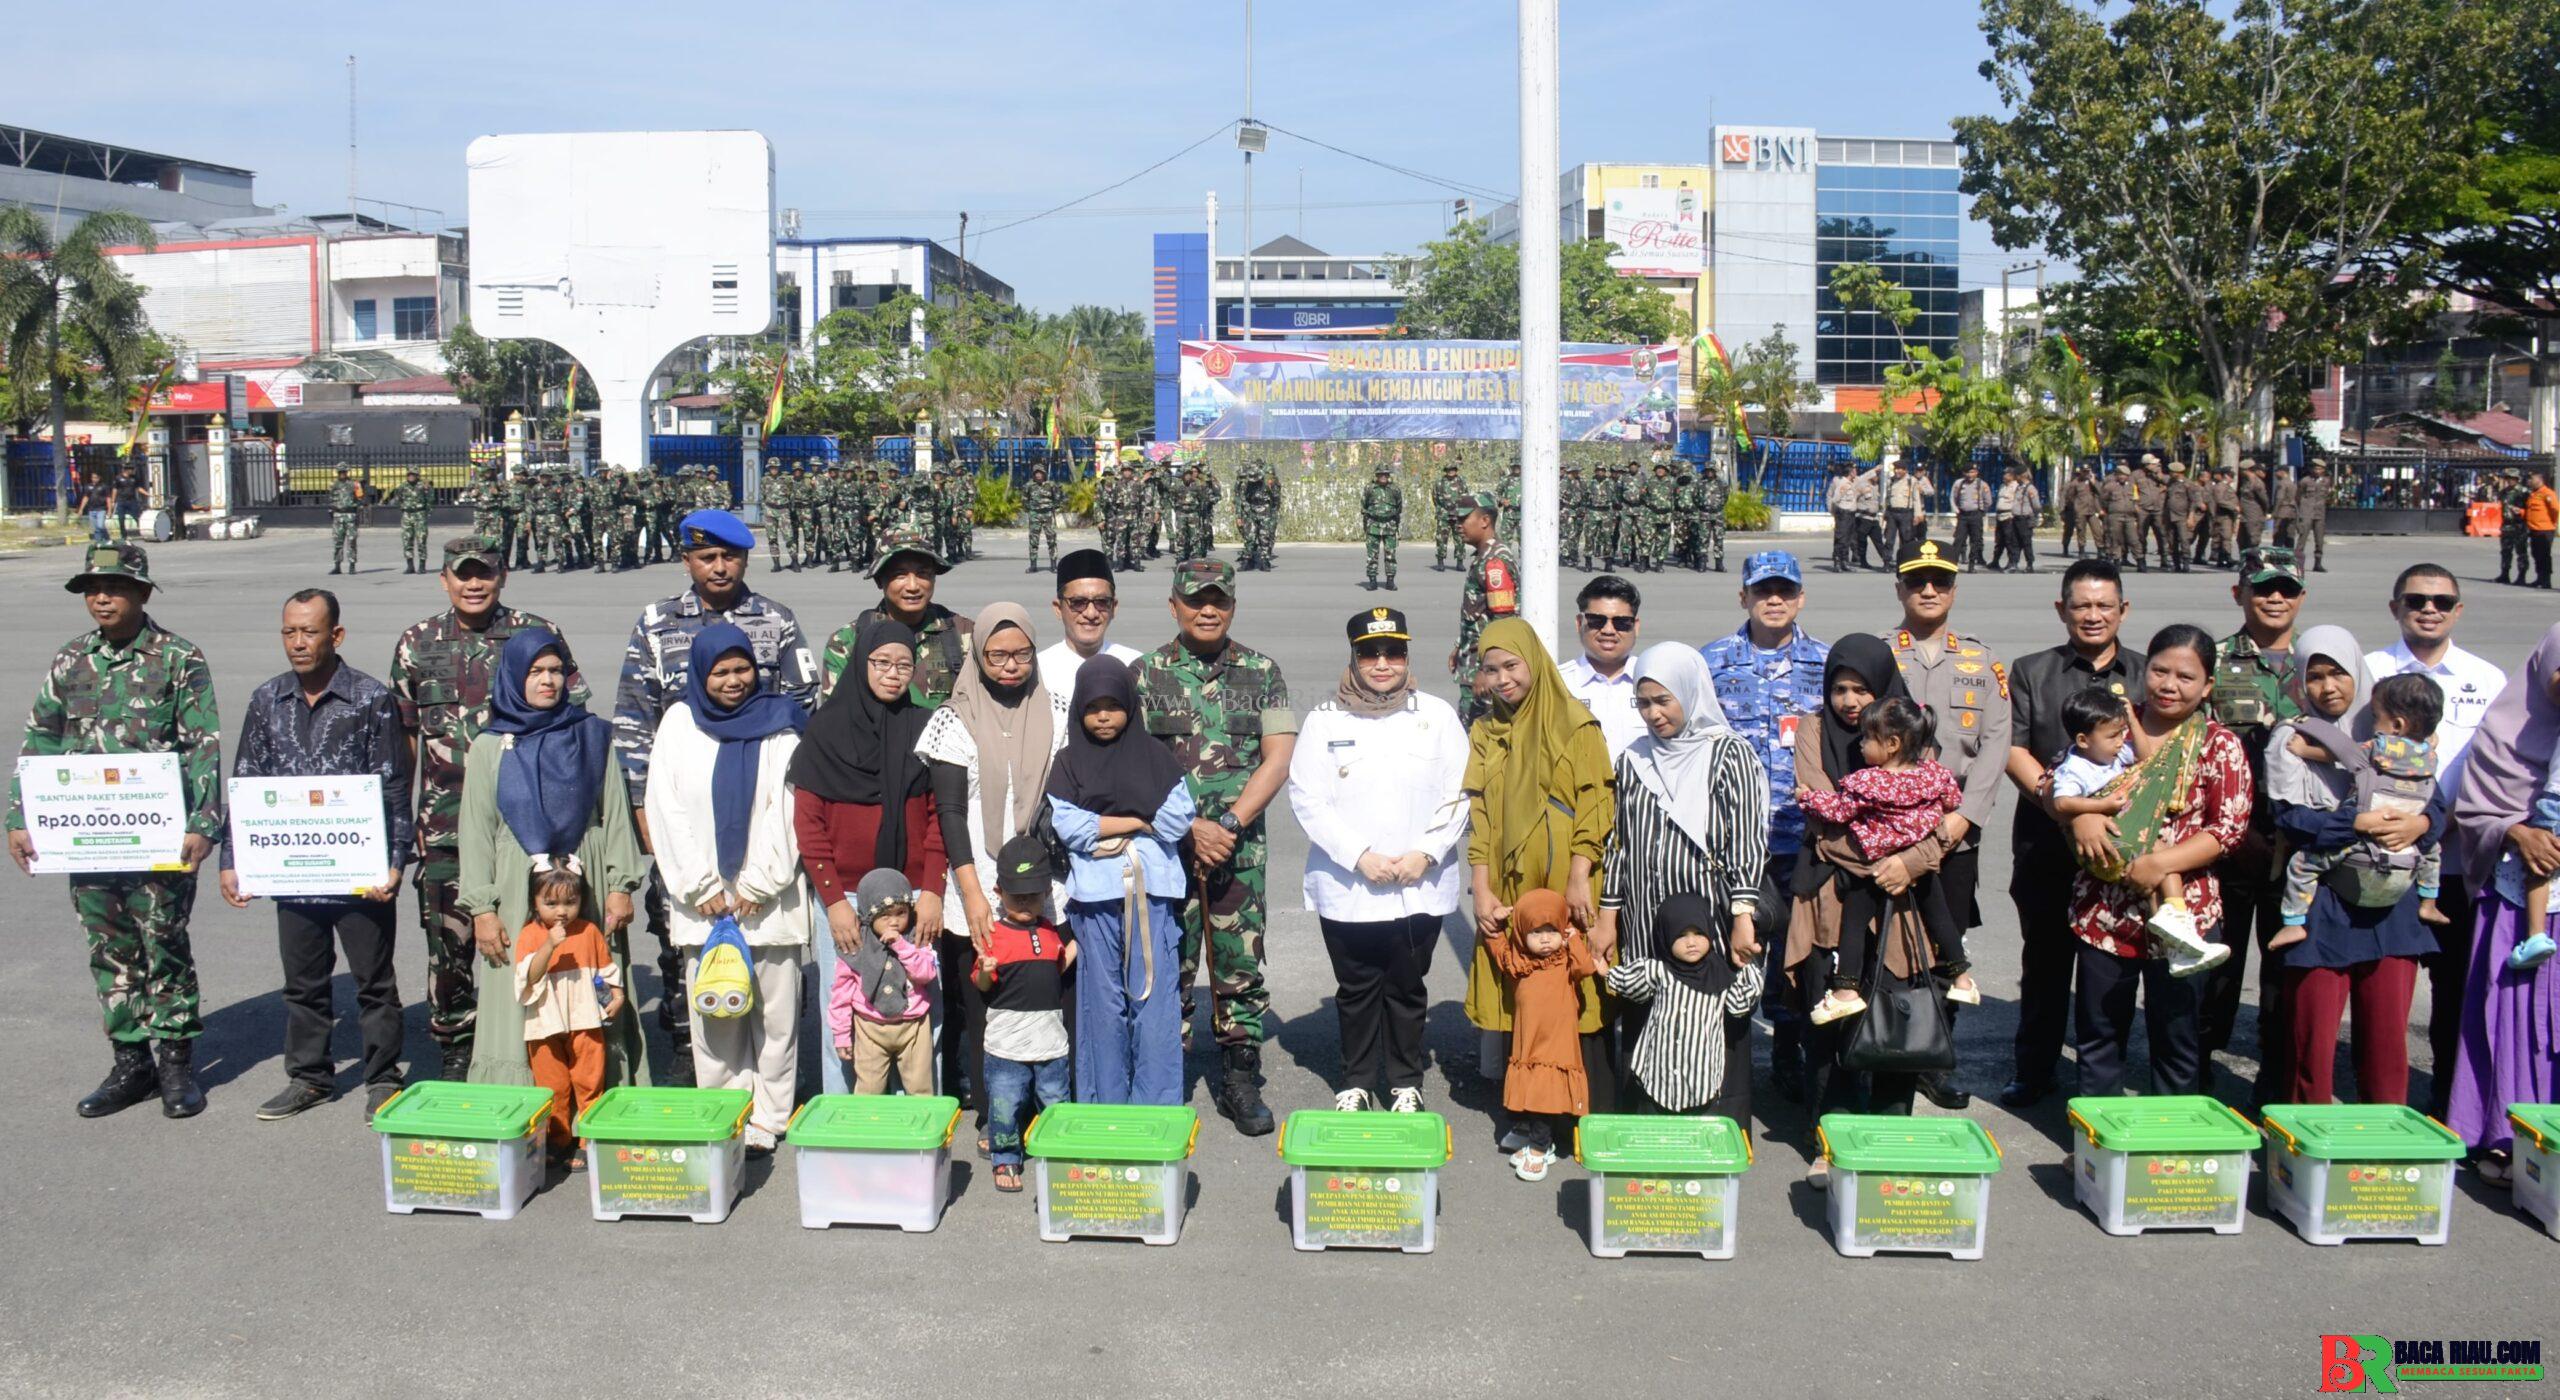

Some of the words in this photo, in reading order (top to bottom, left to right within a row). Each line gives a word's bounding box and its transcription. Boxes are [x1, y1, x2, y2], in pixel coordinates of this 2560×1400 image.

[1756, 136, 1808, 168] BNI
[1308, 313, 1329, 326] BRI
[1328, 348, 1421, 371] UPACARA
[1244, 379, 1267, 402] TNI
[1271, 379, 1363, 402] MANUNGGAL
[1368, 379, 1463, 402] MEMBANGUN
[1467, 379, 1504, 402] DESA
[1582, 381, 1622, 405] 2025
[761, 630, 776, 640] AL
[1953, 676, 1986, 687] POLRI
[2450, 696, 2488, 706] CAMAT
[87, 793, 116, 801] PAKET
[37, 813, 172, 830] Rp20.000.000,-
[290, 818, 334, 826] RENOVASI
[250, 832, 371, 848] Rp30.120.000,-
